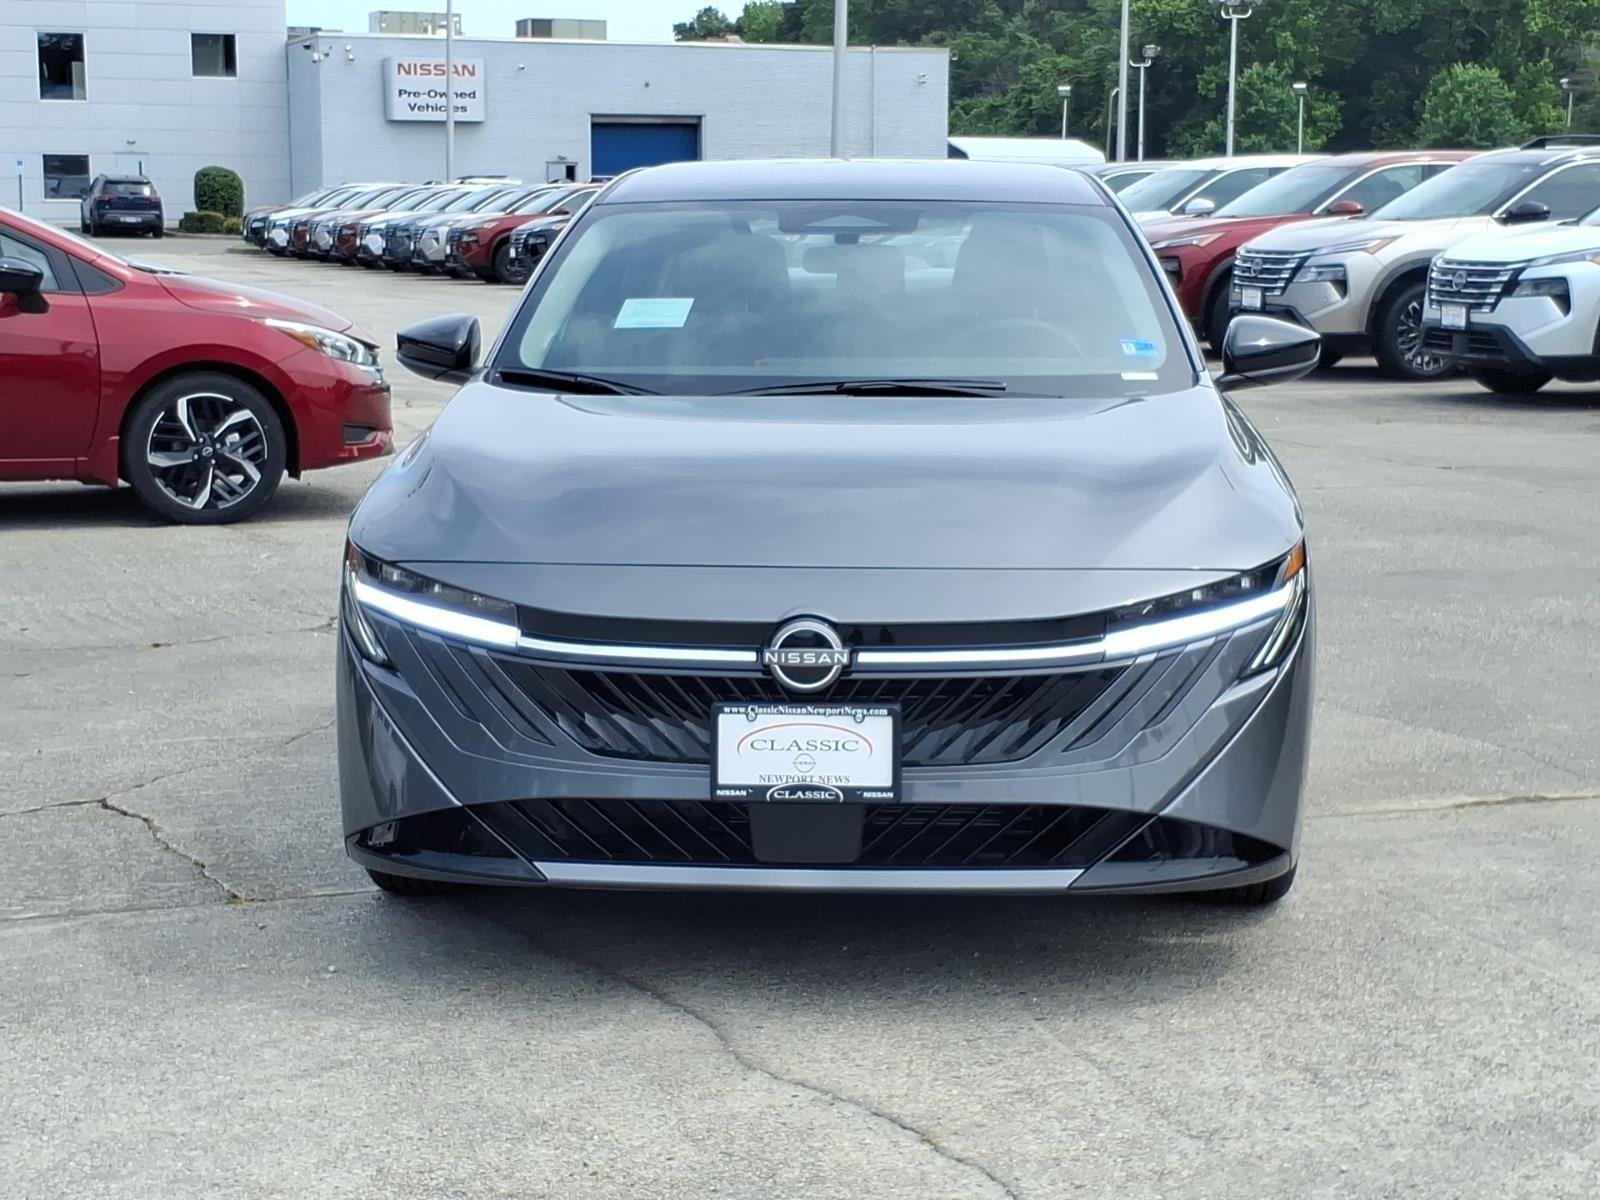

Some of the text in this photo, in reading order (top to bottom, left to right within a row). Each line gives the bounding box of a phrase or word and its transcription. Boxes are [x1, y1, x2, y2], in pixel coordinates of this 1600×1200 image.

[397, 63, 475, 77] NISSAN
[408, 103, 467, 113] Vehices
[765, 652, 847, 664] NISSAN
[723, 705, 888, 717] www.ClassicNissanNewportNews.com
[750, 739, 859, 751] CLASSIC
[759, 774, 814, 783] NEWPORT
[773, 791, 836, 799] CLASSIC
